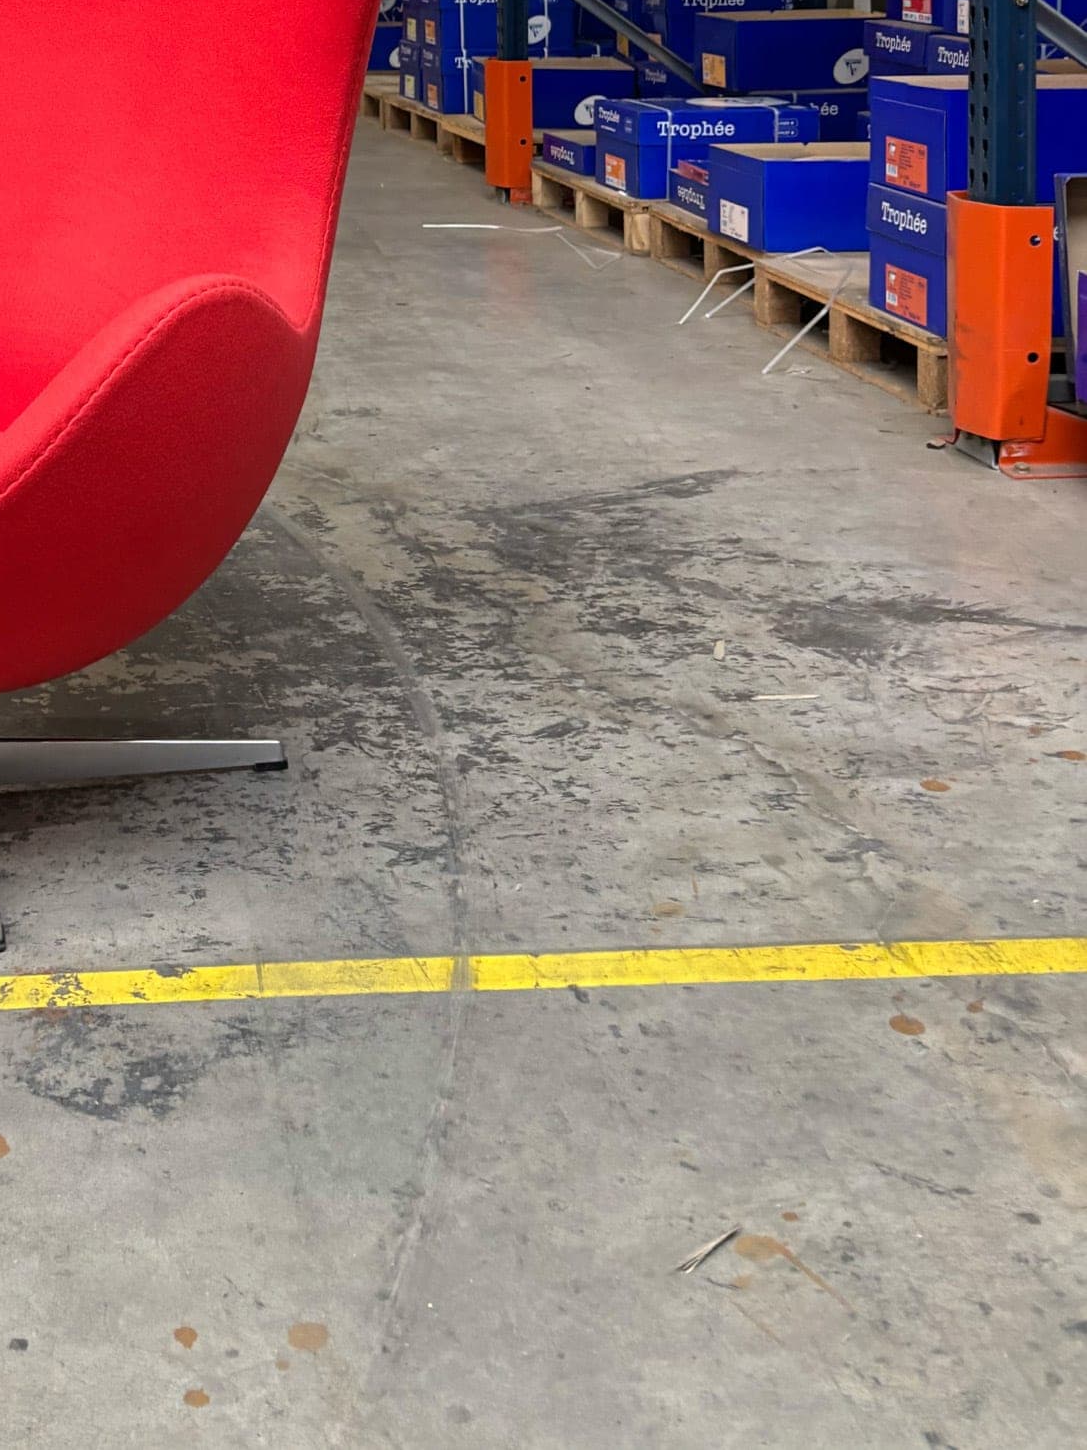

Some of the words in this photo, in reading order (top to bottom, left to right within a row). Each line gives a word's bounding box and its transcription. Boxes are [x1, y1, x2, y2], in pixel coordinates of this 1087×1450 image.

[875, 31, 912, 53] Trophée
[937, 46, 970, 68] Trophé
[657, 120, 736, 140] Trophée
[881, 200, 929, 236] Trophée
